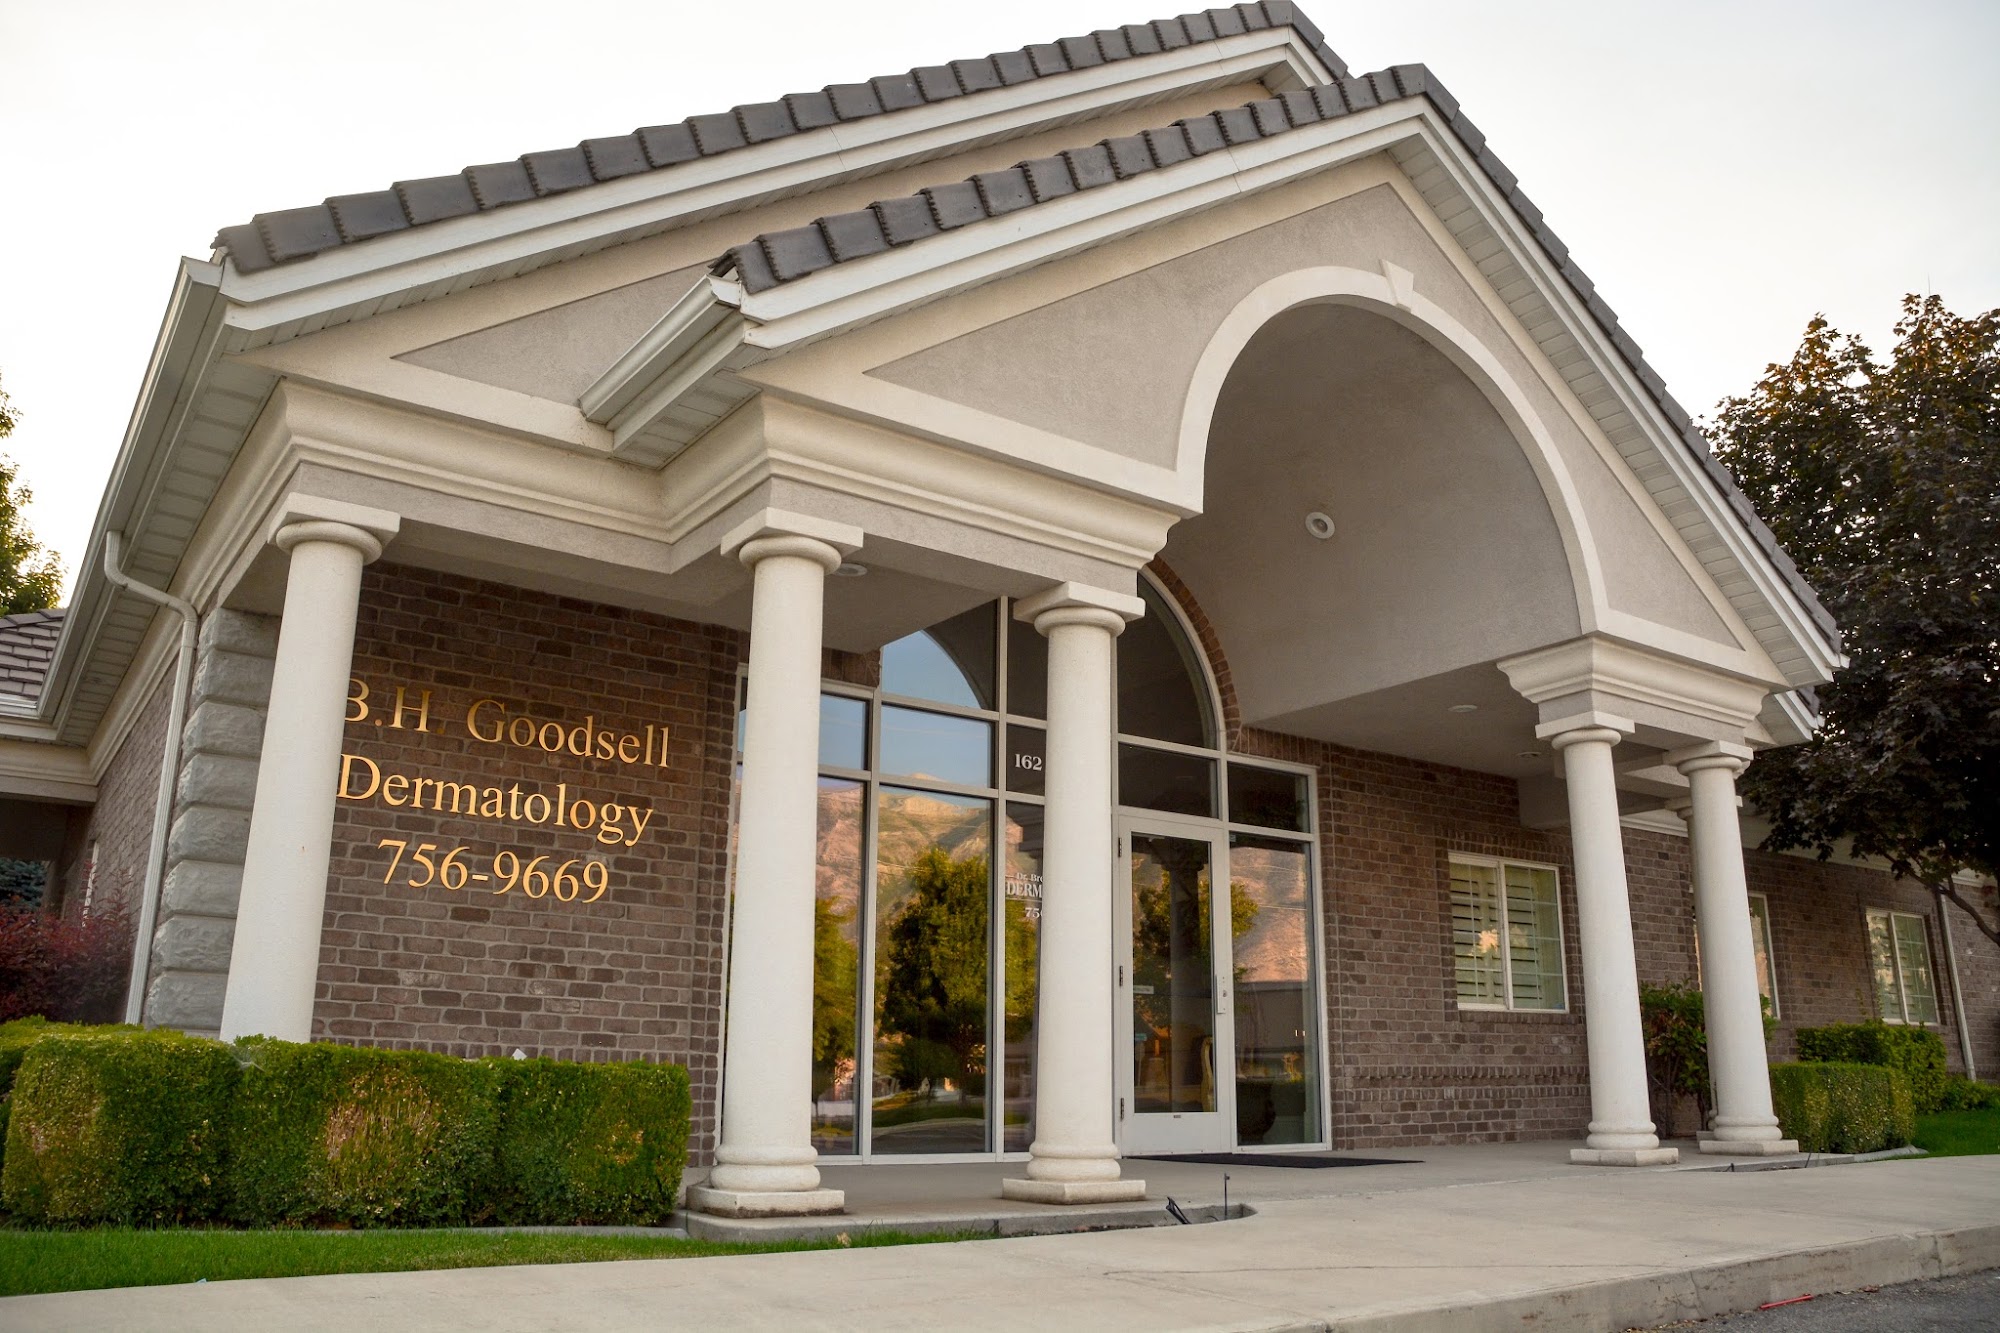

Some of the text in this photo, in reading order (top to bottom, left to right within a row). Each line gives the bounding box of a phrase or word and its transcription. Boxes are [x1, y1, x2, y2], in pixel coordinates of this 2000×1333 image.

[345, 678, 670, 769] B.H. Goodsell
[1015, 754, 1042, 771] 162
[336, 754, 654, 848] Dermatology
[377, 839, 610, 904] 756-9669
[1016, 872, 1028, 881] Dr.
[1025, 907, 1042, 919] 75
